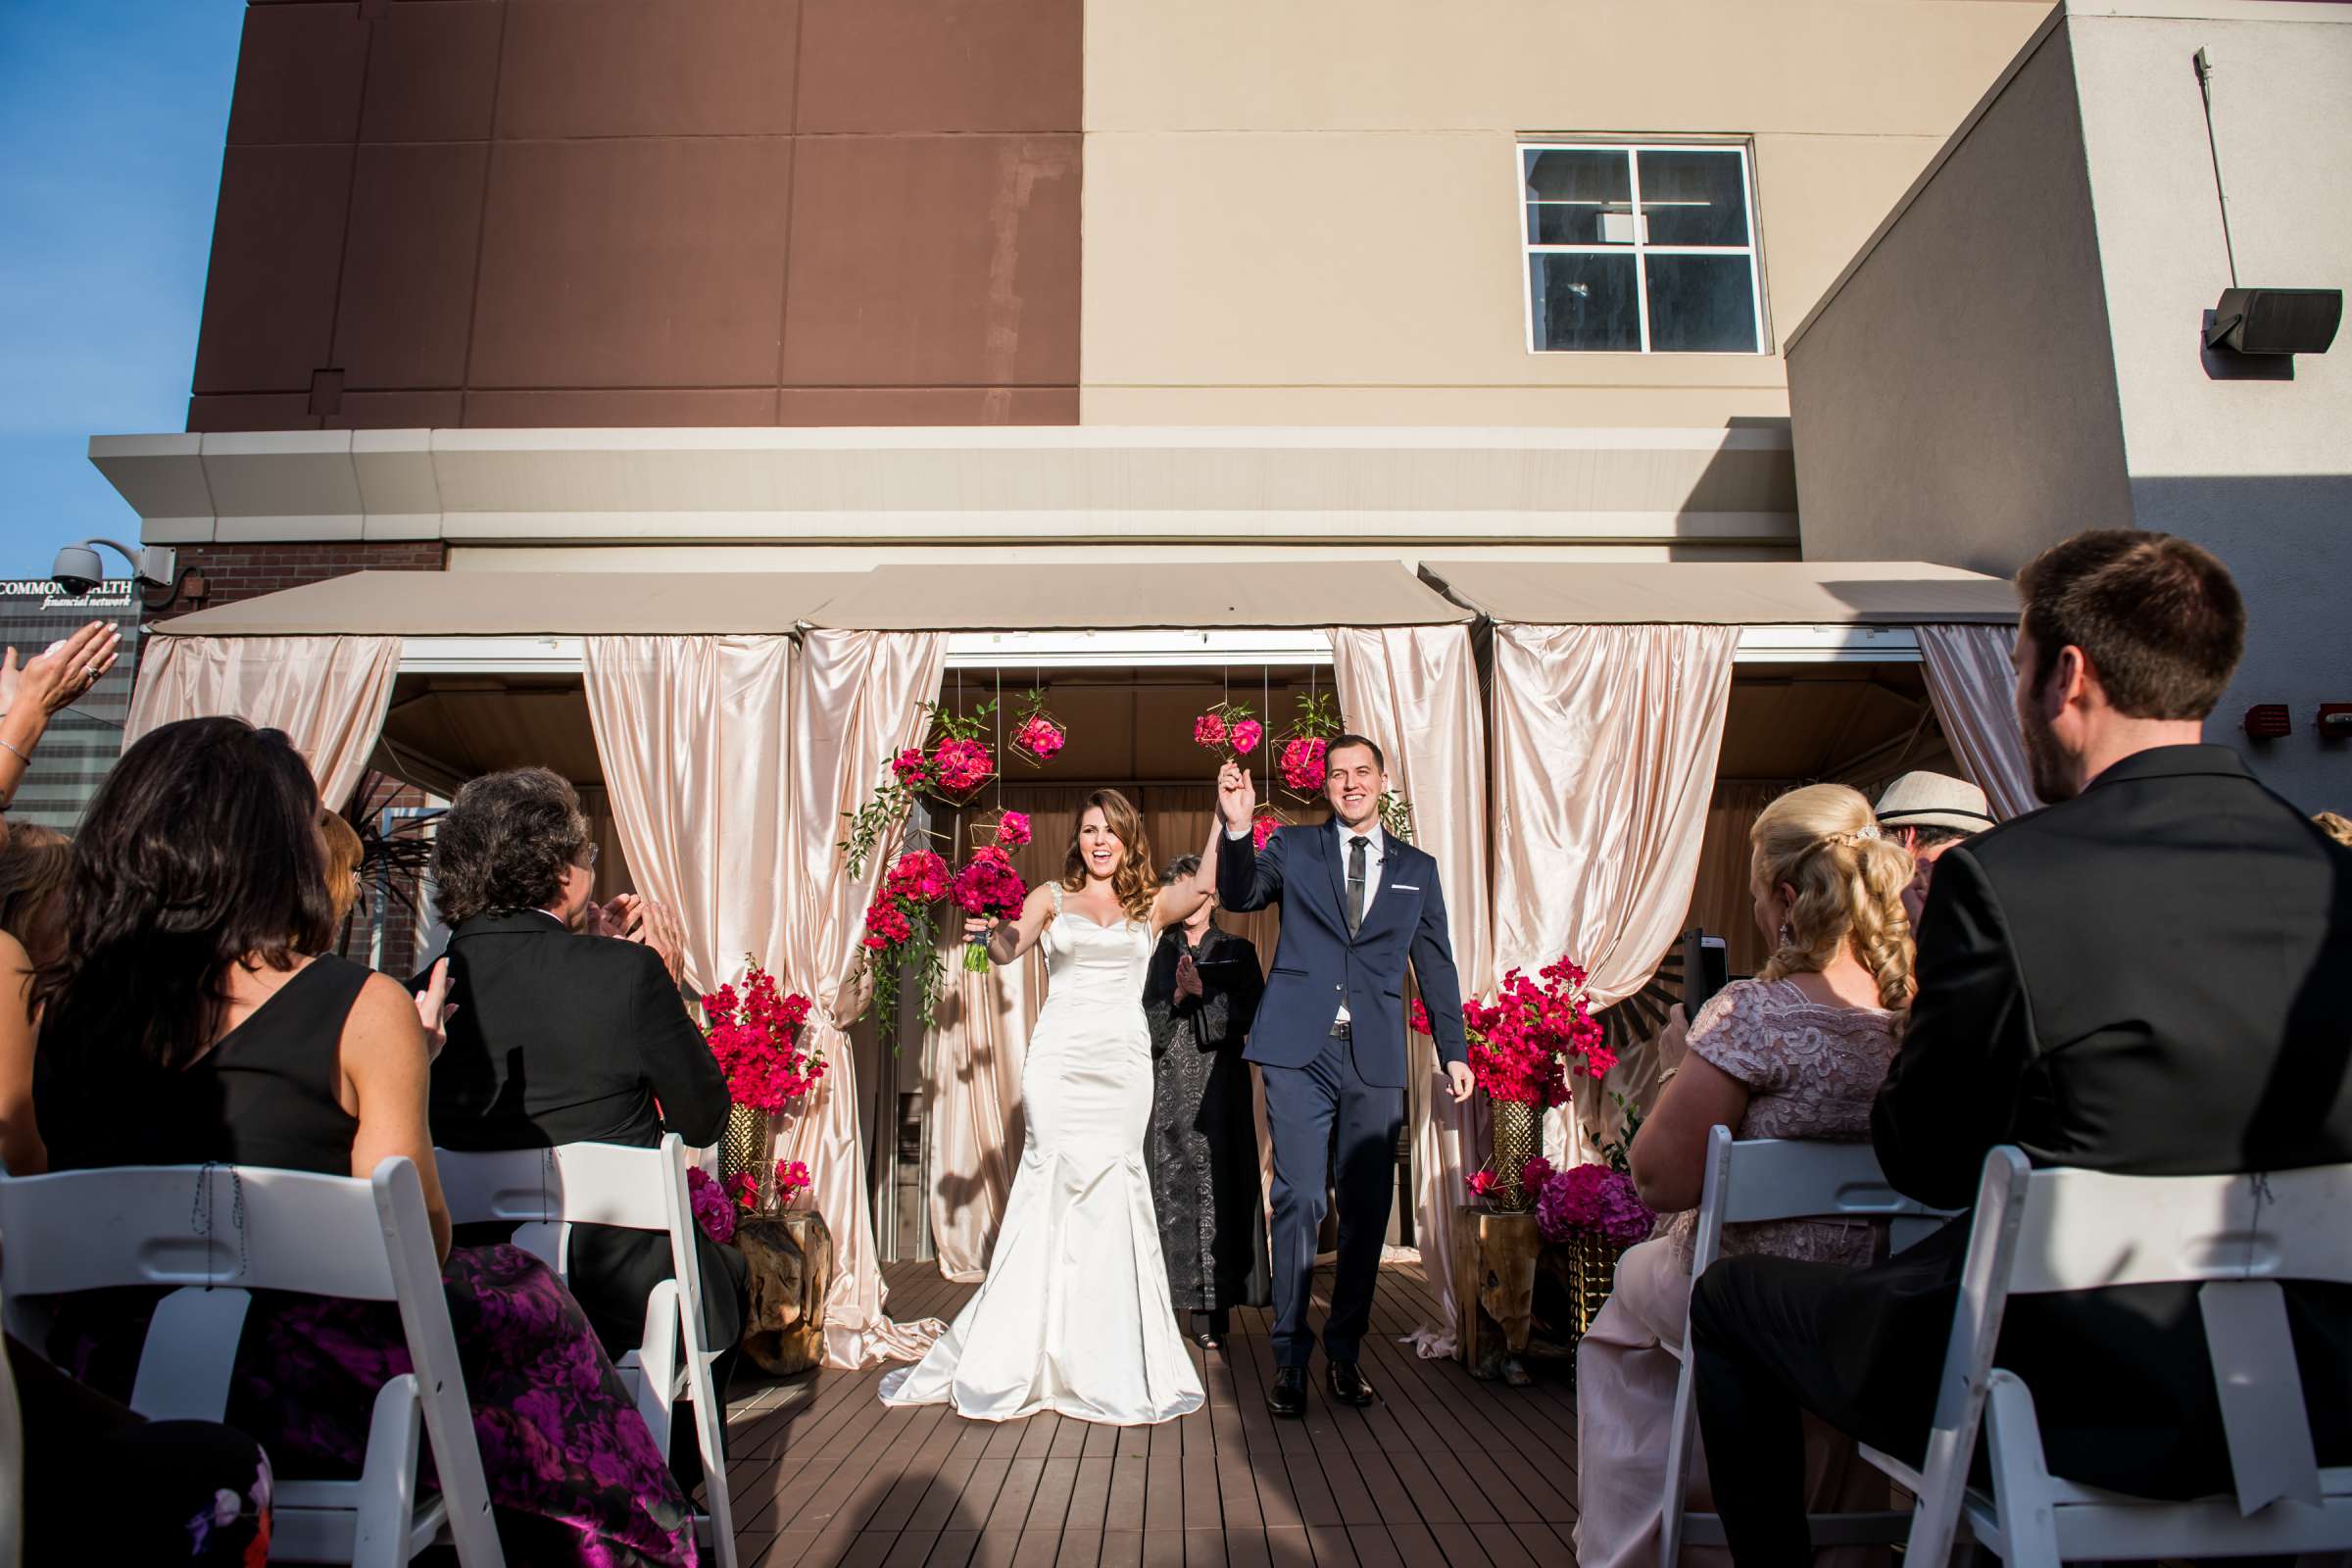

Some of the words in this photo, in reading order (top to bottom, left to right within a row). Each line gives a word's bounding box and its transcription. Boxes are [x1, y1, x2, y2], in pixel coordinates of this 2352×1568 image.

[0, 581, 132, 595] COMMONALTH
[40, 595, 90, 610] financial
[89, 595, 131, 607] network
